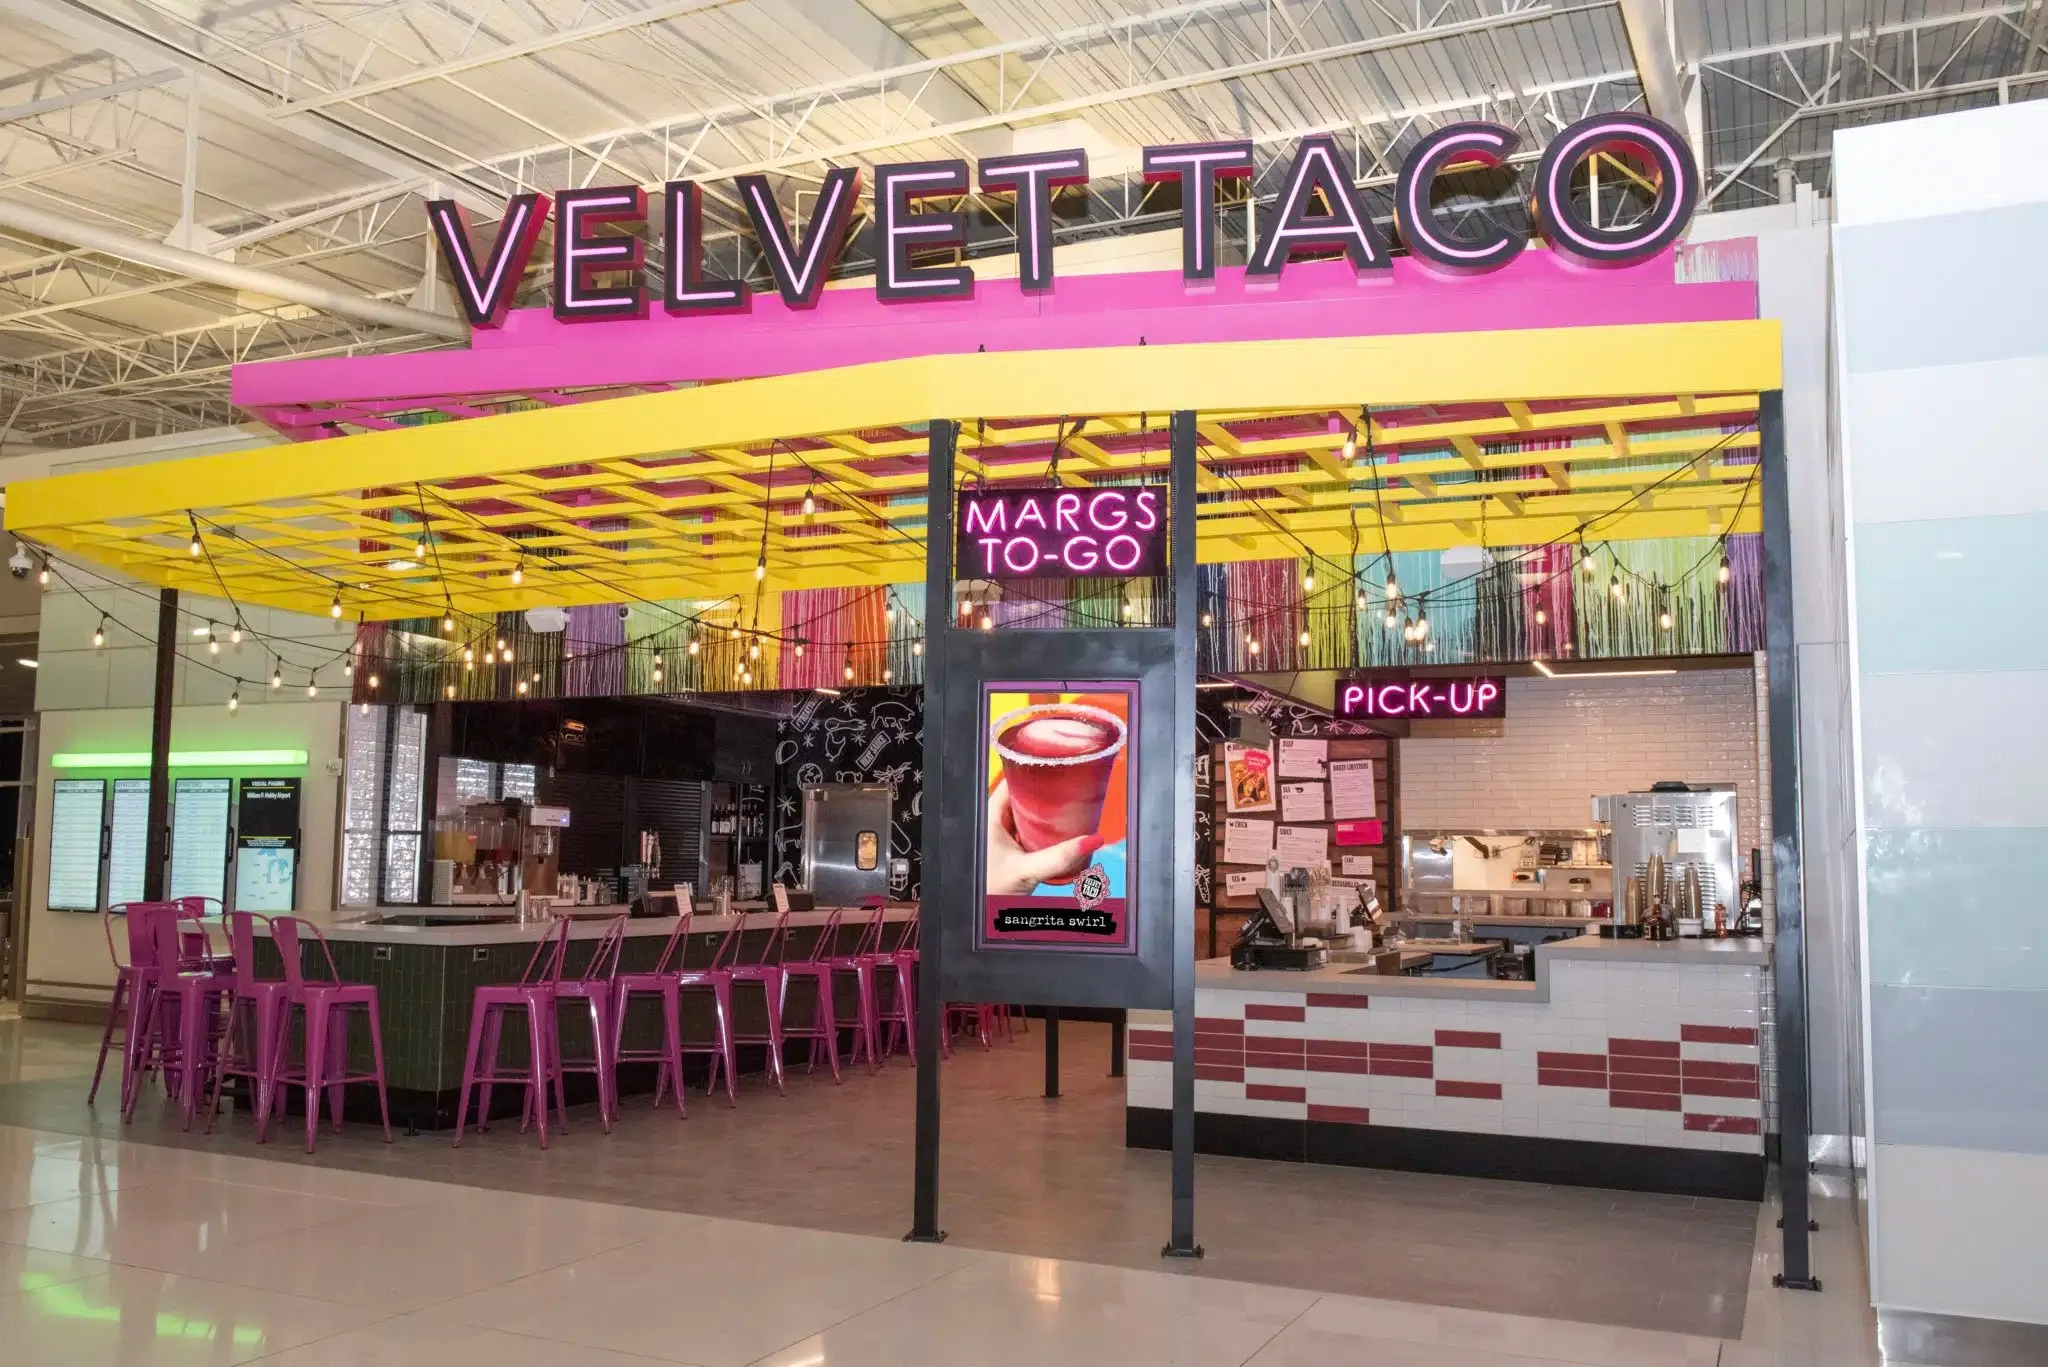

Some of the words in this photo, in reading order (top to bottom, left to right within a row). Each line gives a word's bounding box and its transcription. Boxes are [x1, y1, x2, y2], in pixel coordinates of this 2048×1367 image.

[425, 148, 1089, 330] VELVET
[1142, 111, 1699, 290] TACO
[965, 491, 1157, 534] MARGS
[978, 535, 1142, 574] TO-GO
[1343, 683, 1499, 714] PICK-UP
[1082, 884, 1099, 898] TACO
[1004, 914, 1065, 928] sangrita
[1068, 916, 1107, 928] swirl
